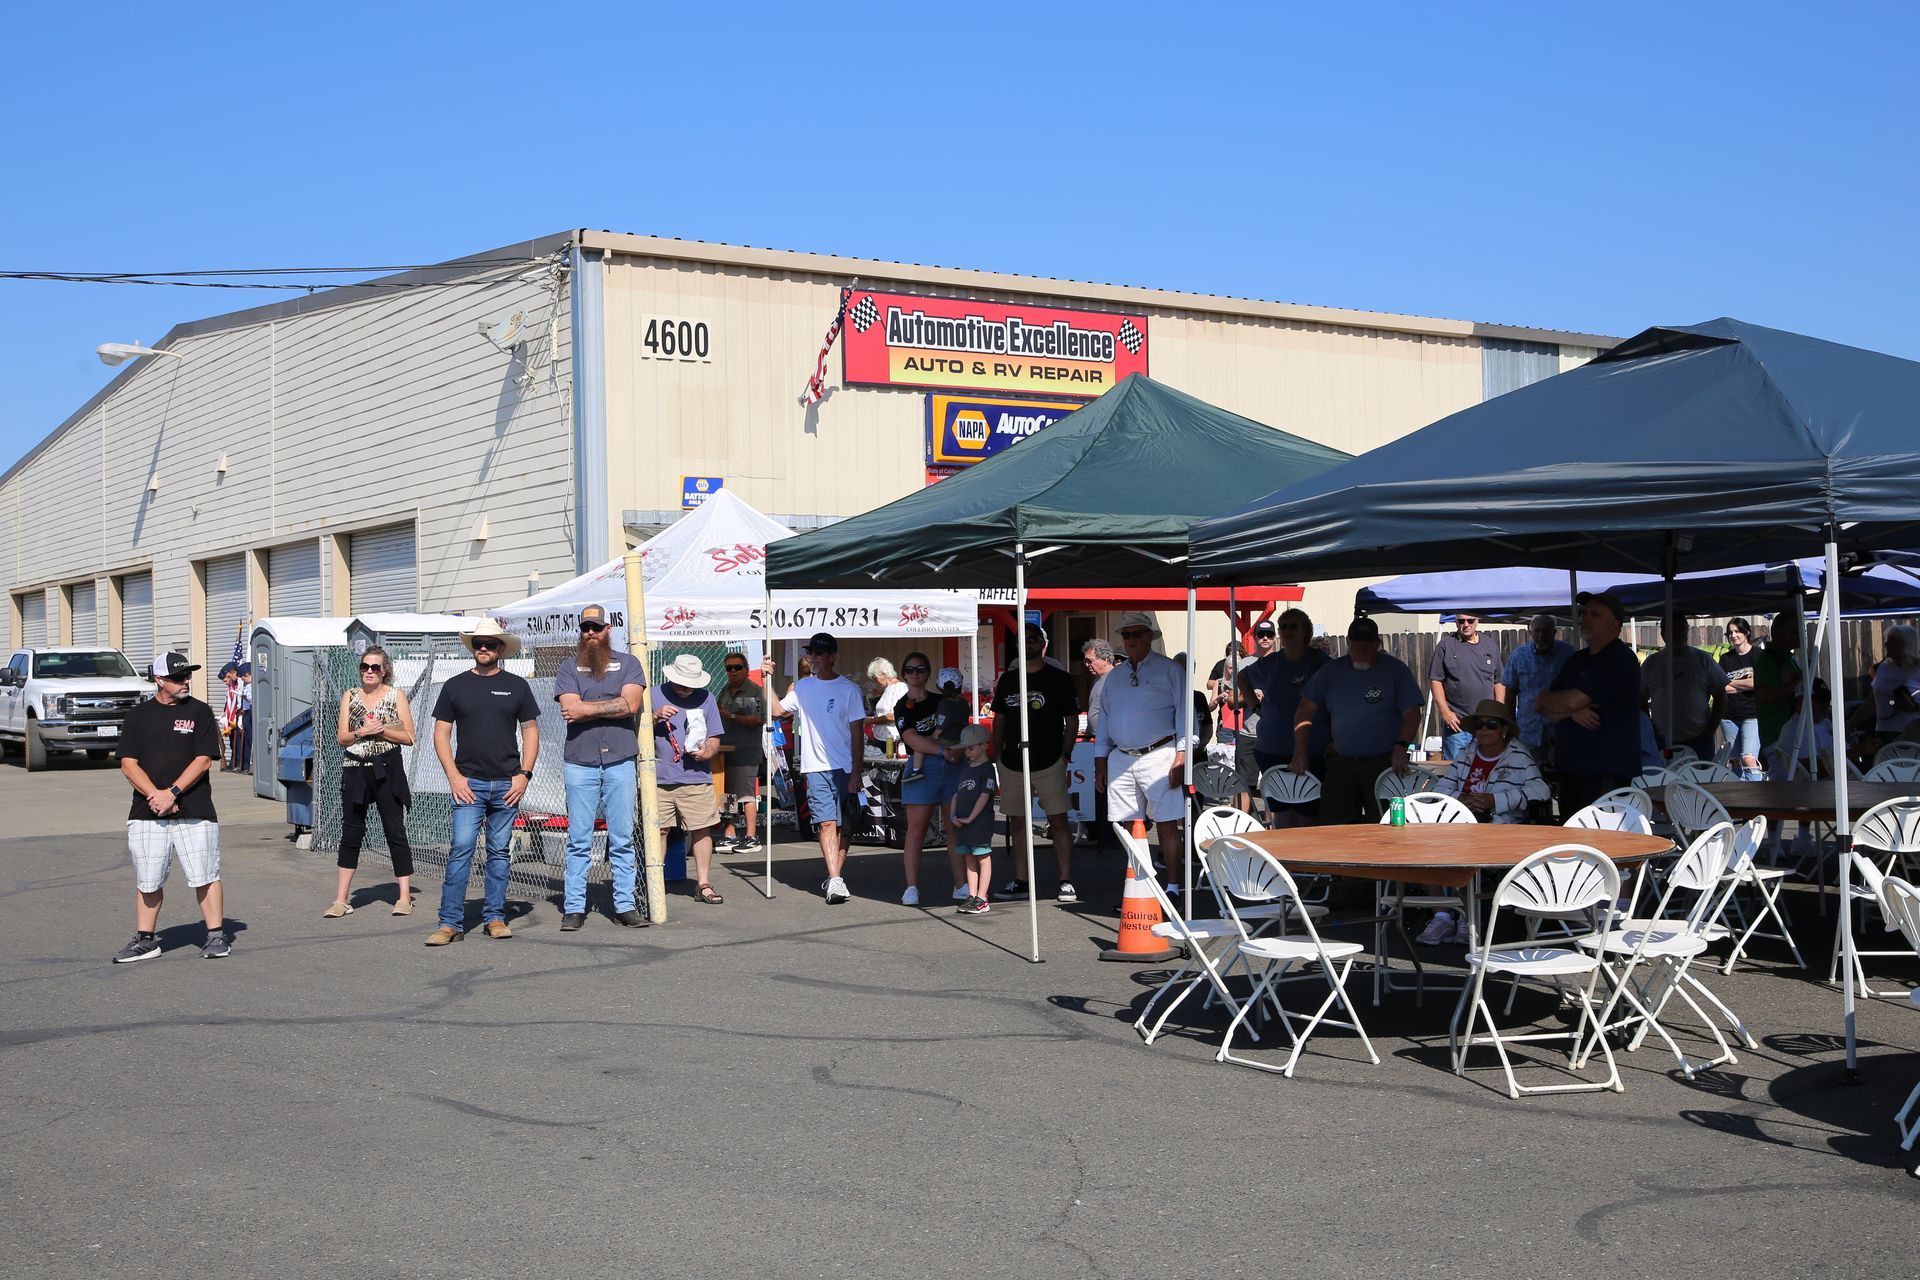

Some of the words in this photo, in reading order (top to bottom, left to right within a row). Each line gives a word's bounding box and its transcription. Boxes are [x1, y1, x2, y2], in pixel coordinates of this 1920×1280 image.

[644, 319, 709, 358] 4600
[887, 308, 1006, 353] Automotive
[1008, 319, 1114, 361] Excellence
[903, 356, 965, 375] AUTO
[971, 361, 987, 376] &
[993, 364, 1023, 378] RV
[1029, 366, 1103, 384] REPAIR
[958, 420, 985, 440] NAPA
[995, 412, 1059, 436] AUTOC
[979, 588, 1017, 600] RAFFLE
[526, 613, 580, 636] 530.677.87
[660, 605, 697, 631] Solis
[897, 603, 929, 627] Solis
[174, 719, 195, 730] SEMA
[1121, 921, 1152, 931] Hester
[1122, 911, 1158, 921] cGuire&
